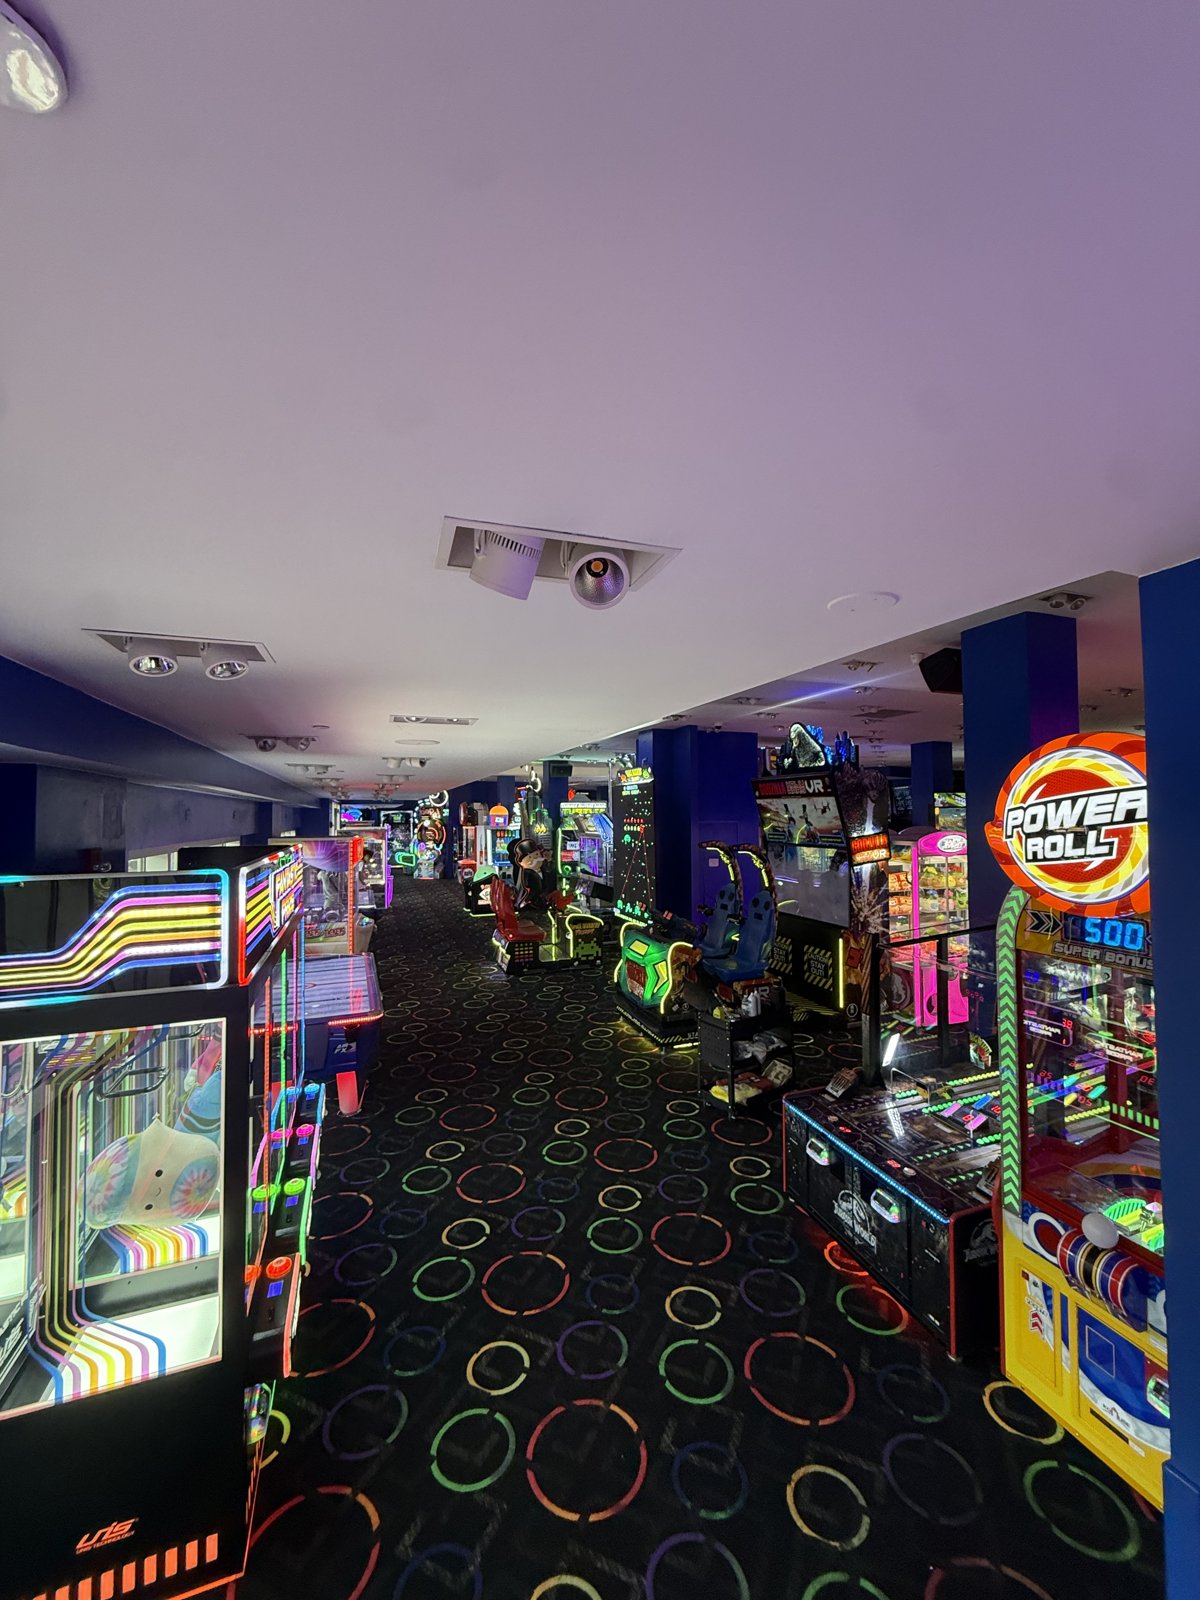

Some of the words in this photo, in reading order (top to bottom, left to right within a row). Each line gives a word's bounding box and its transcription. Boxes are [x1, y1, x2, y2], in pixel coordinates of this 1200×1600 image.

[804, 779, 824, 794] VR
[1006, 788, 1148, 836] POWER
[1026, 830, 1110, 861] ROLL
[1084, 917, 1145, 951] 500
[1054, 942, 1101, 960] SUPER
[810, 960, 825, 971] STAY
